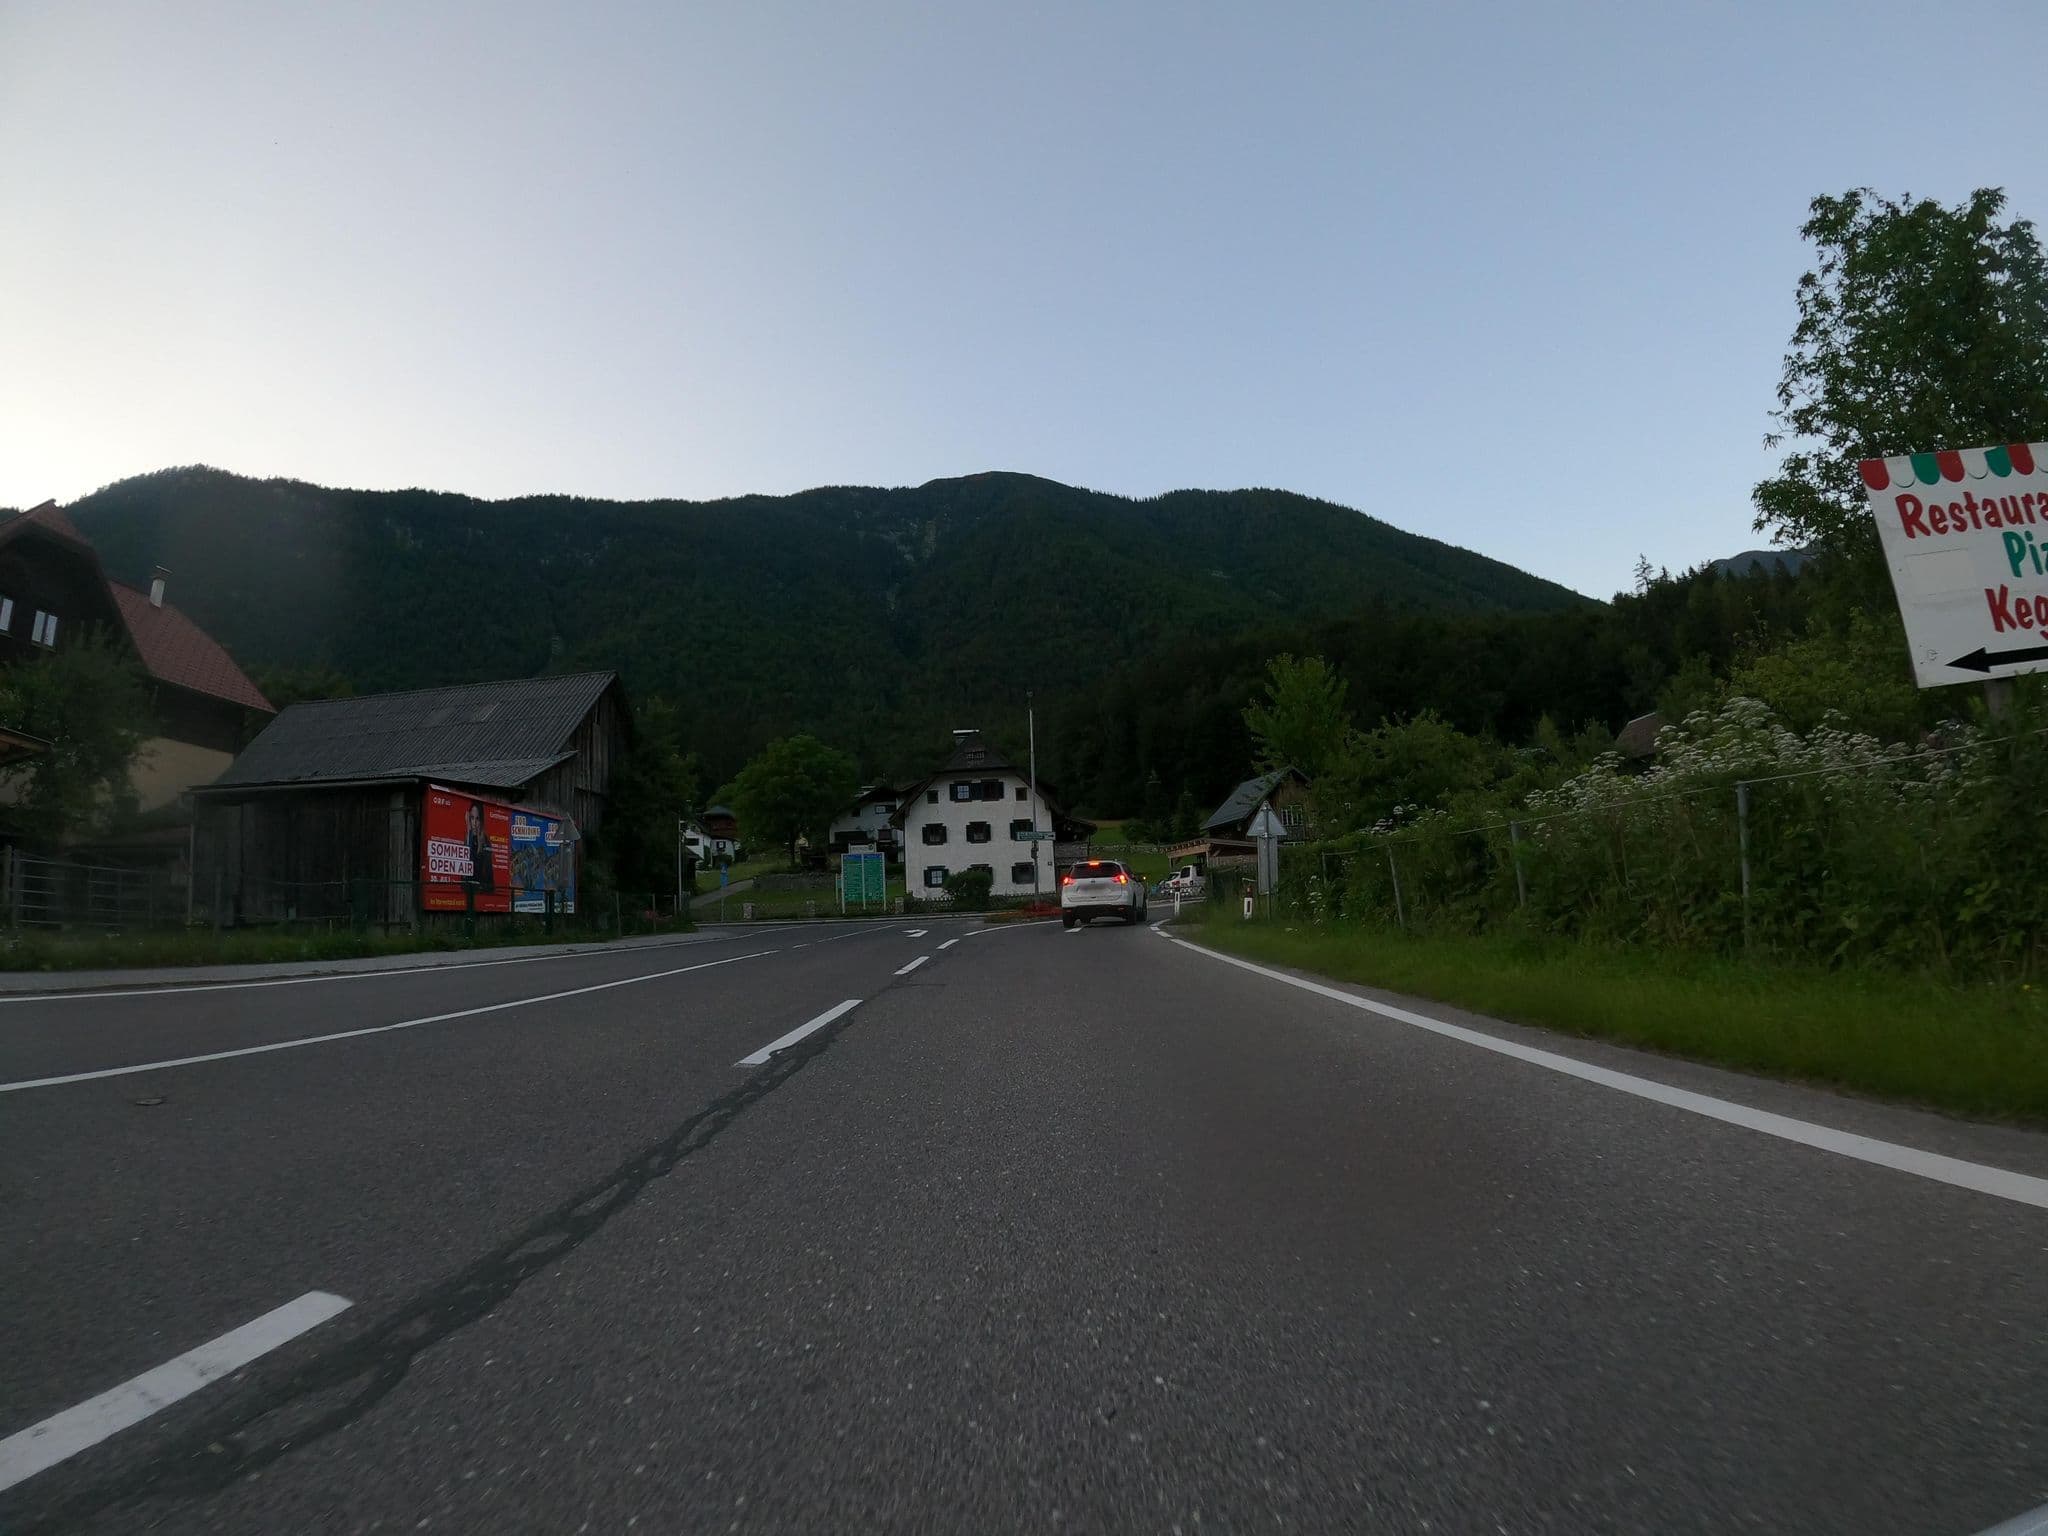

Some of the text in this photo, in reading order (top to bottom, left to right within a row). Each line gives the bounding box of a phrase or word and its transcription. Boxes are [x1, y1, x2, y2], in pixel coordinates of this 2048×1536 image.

[430, 843, 469, 859] SOMMER
[430, 859, 473, 875] OPEN AIR
